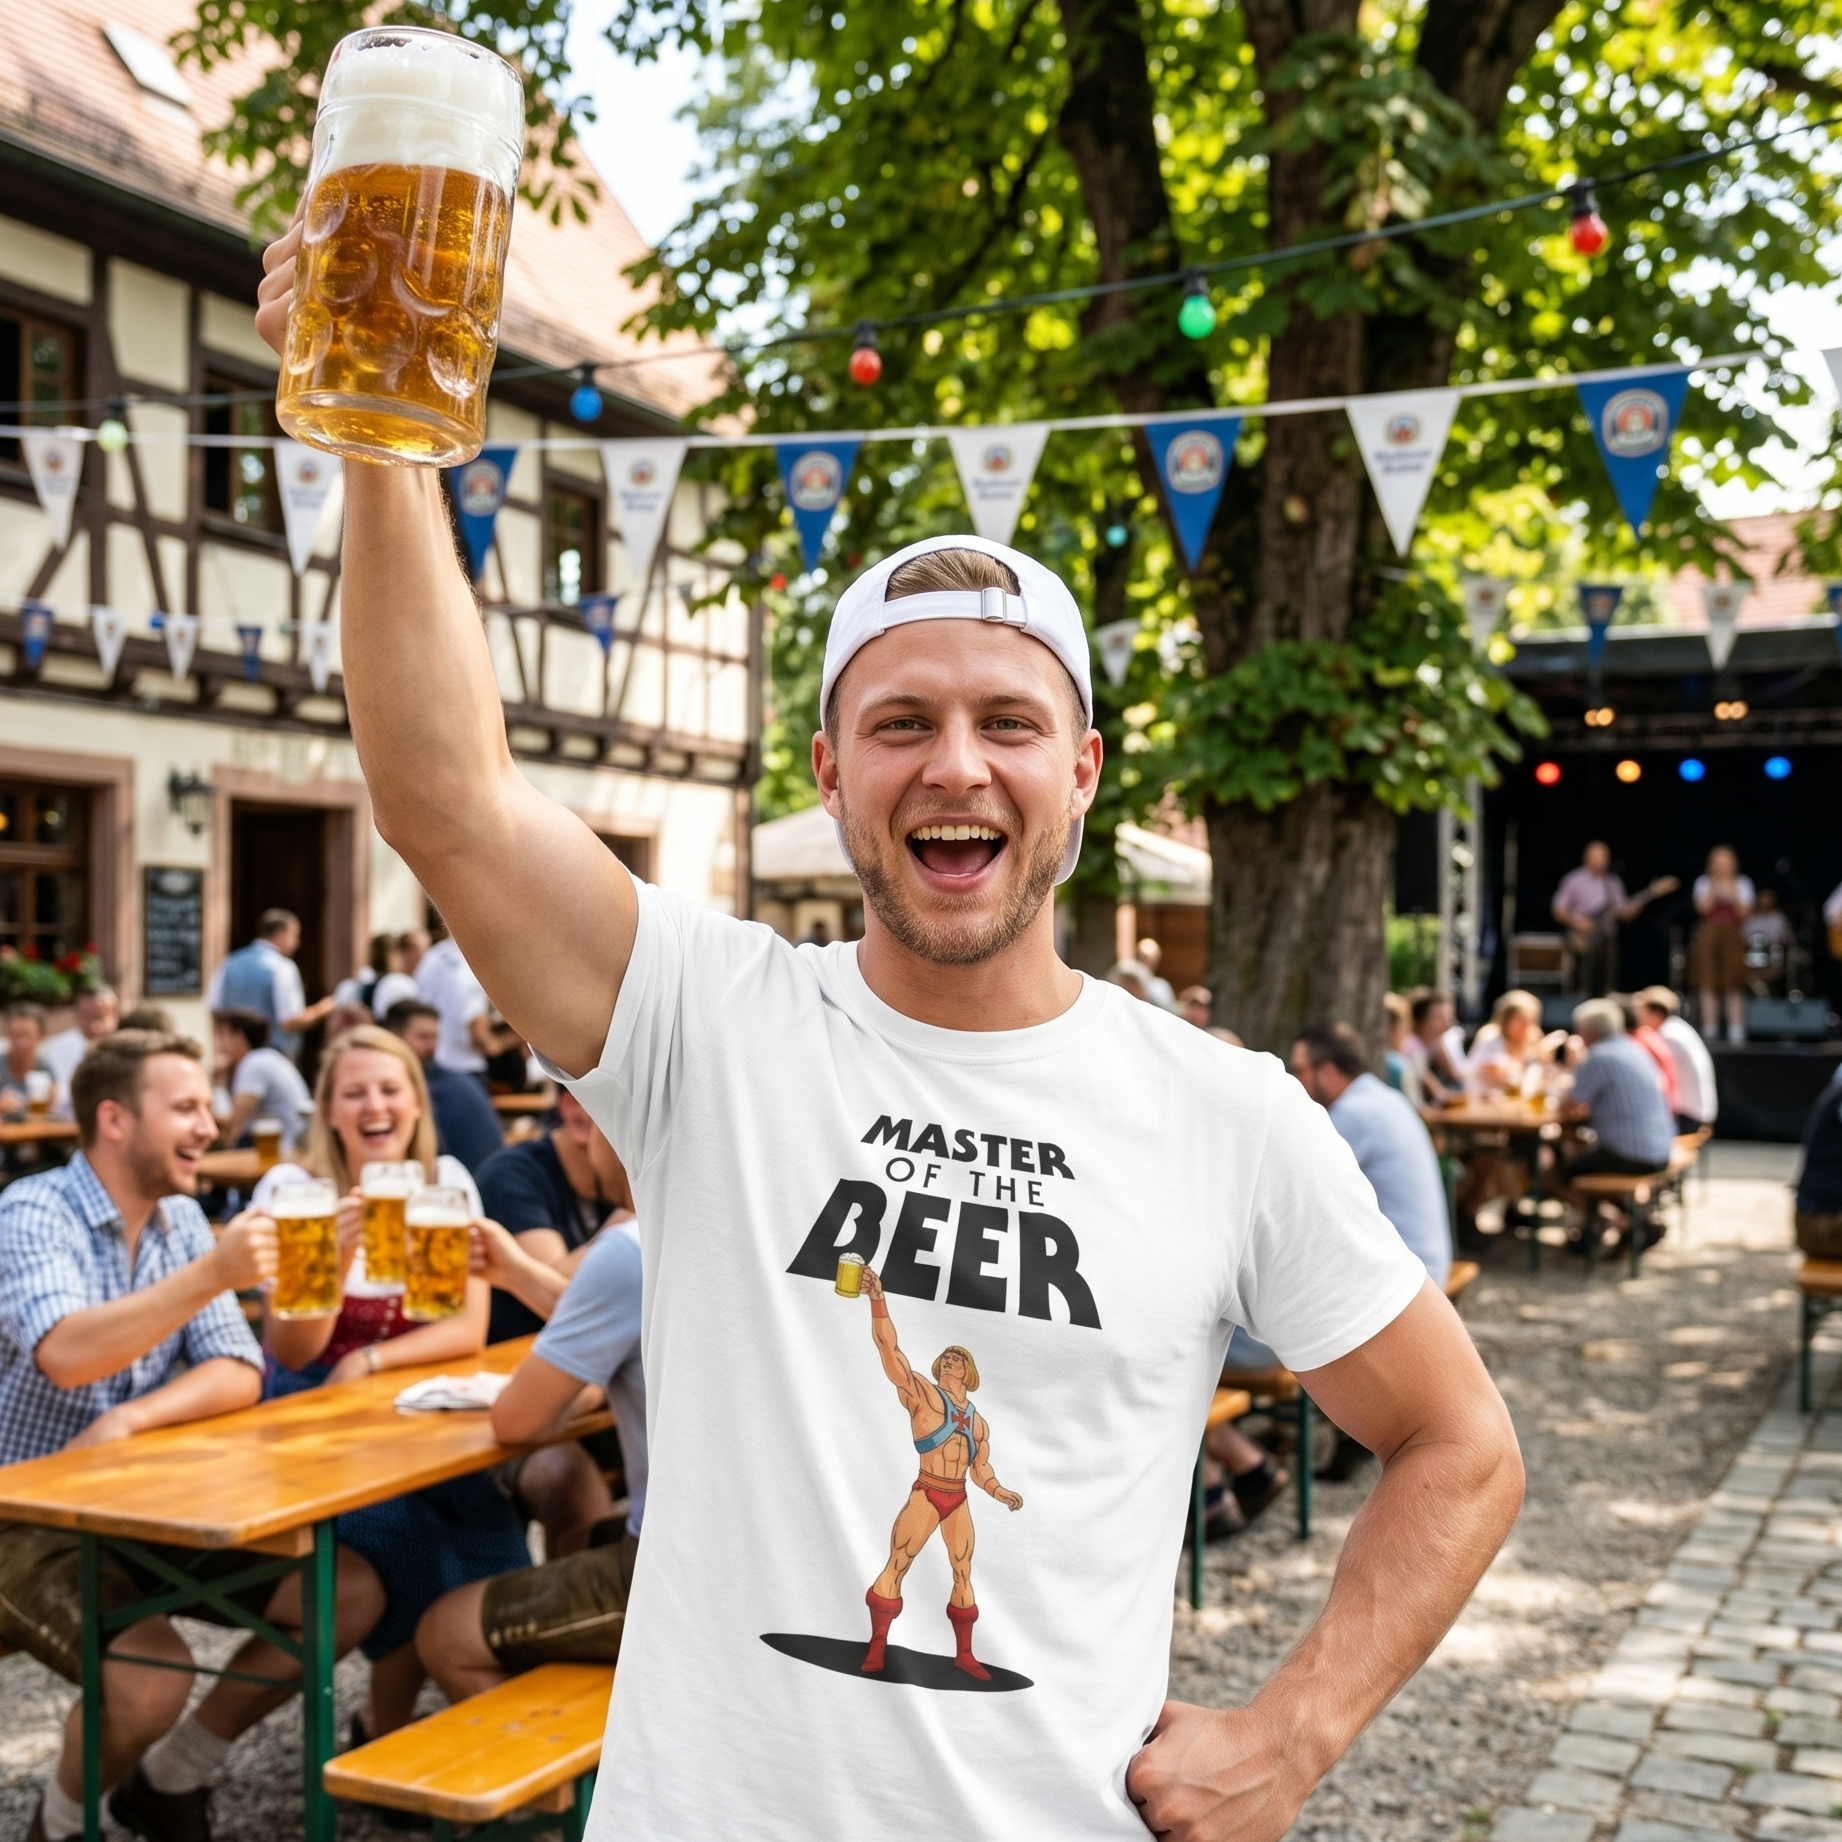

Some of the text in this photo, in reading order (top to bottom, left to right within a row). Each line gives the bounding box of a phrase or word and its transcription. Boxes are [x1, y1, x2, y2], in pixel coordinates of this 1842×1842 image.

[860, 1114, 1076, 1180] MASTER
[885, 1157, 1045, 1207] OF THE
[785, 1178, 1103, 1330] BEER
